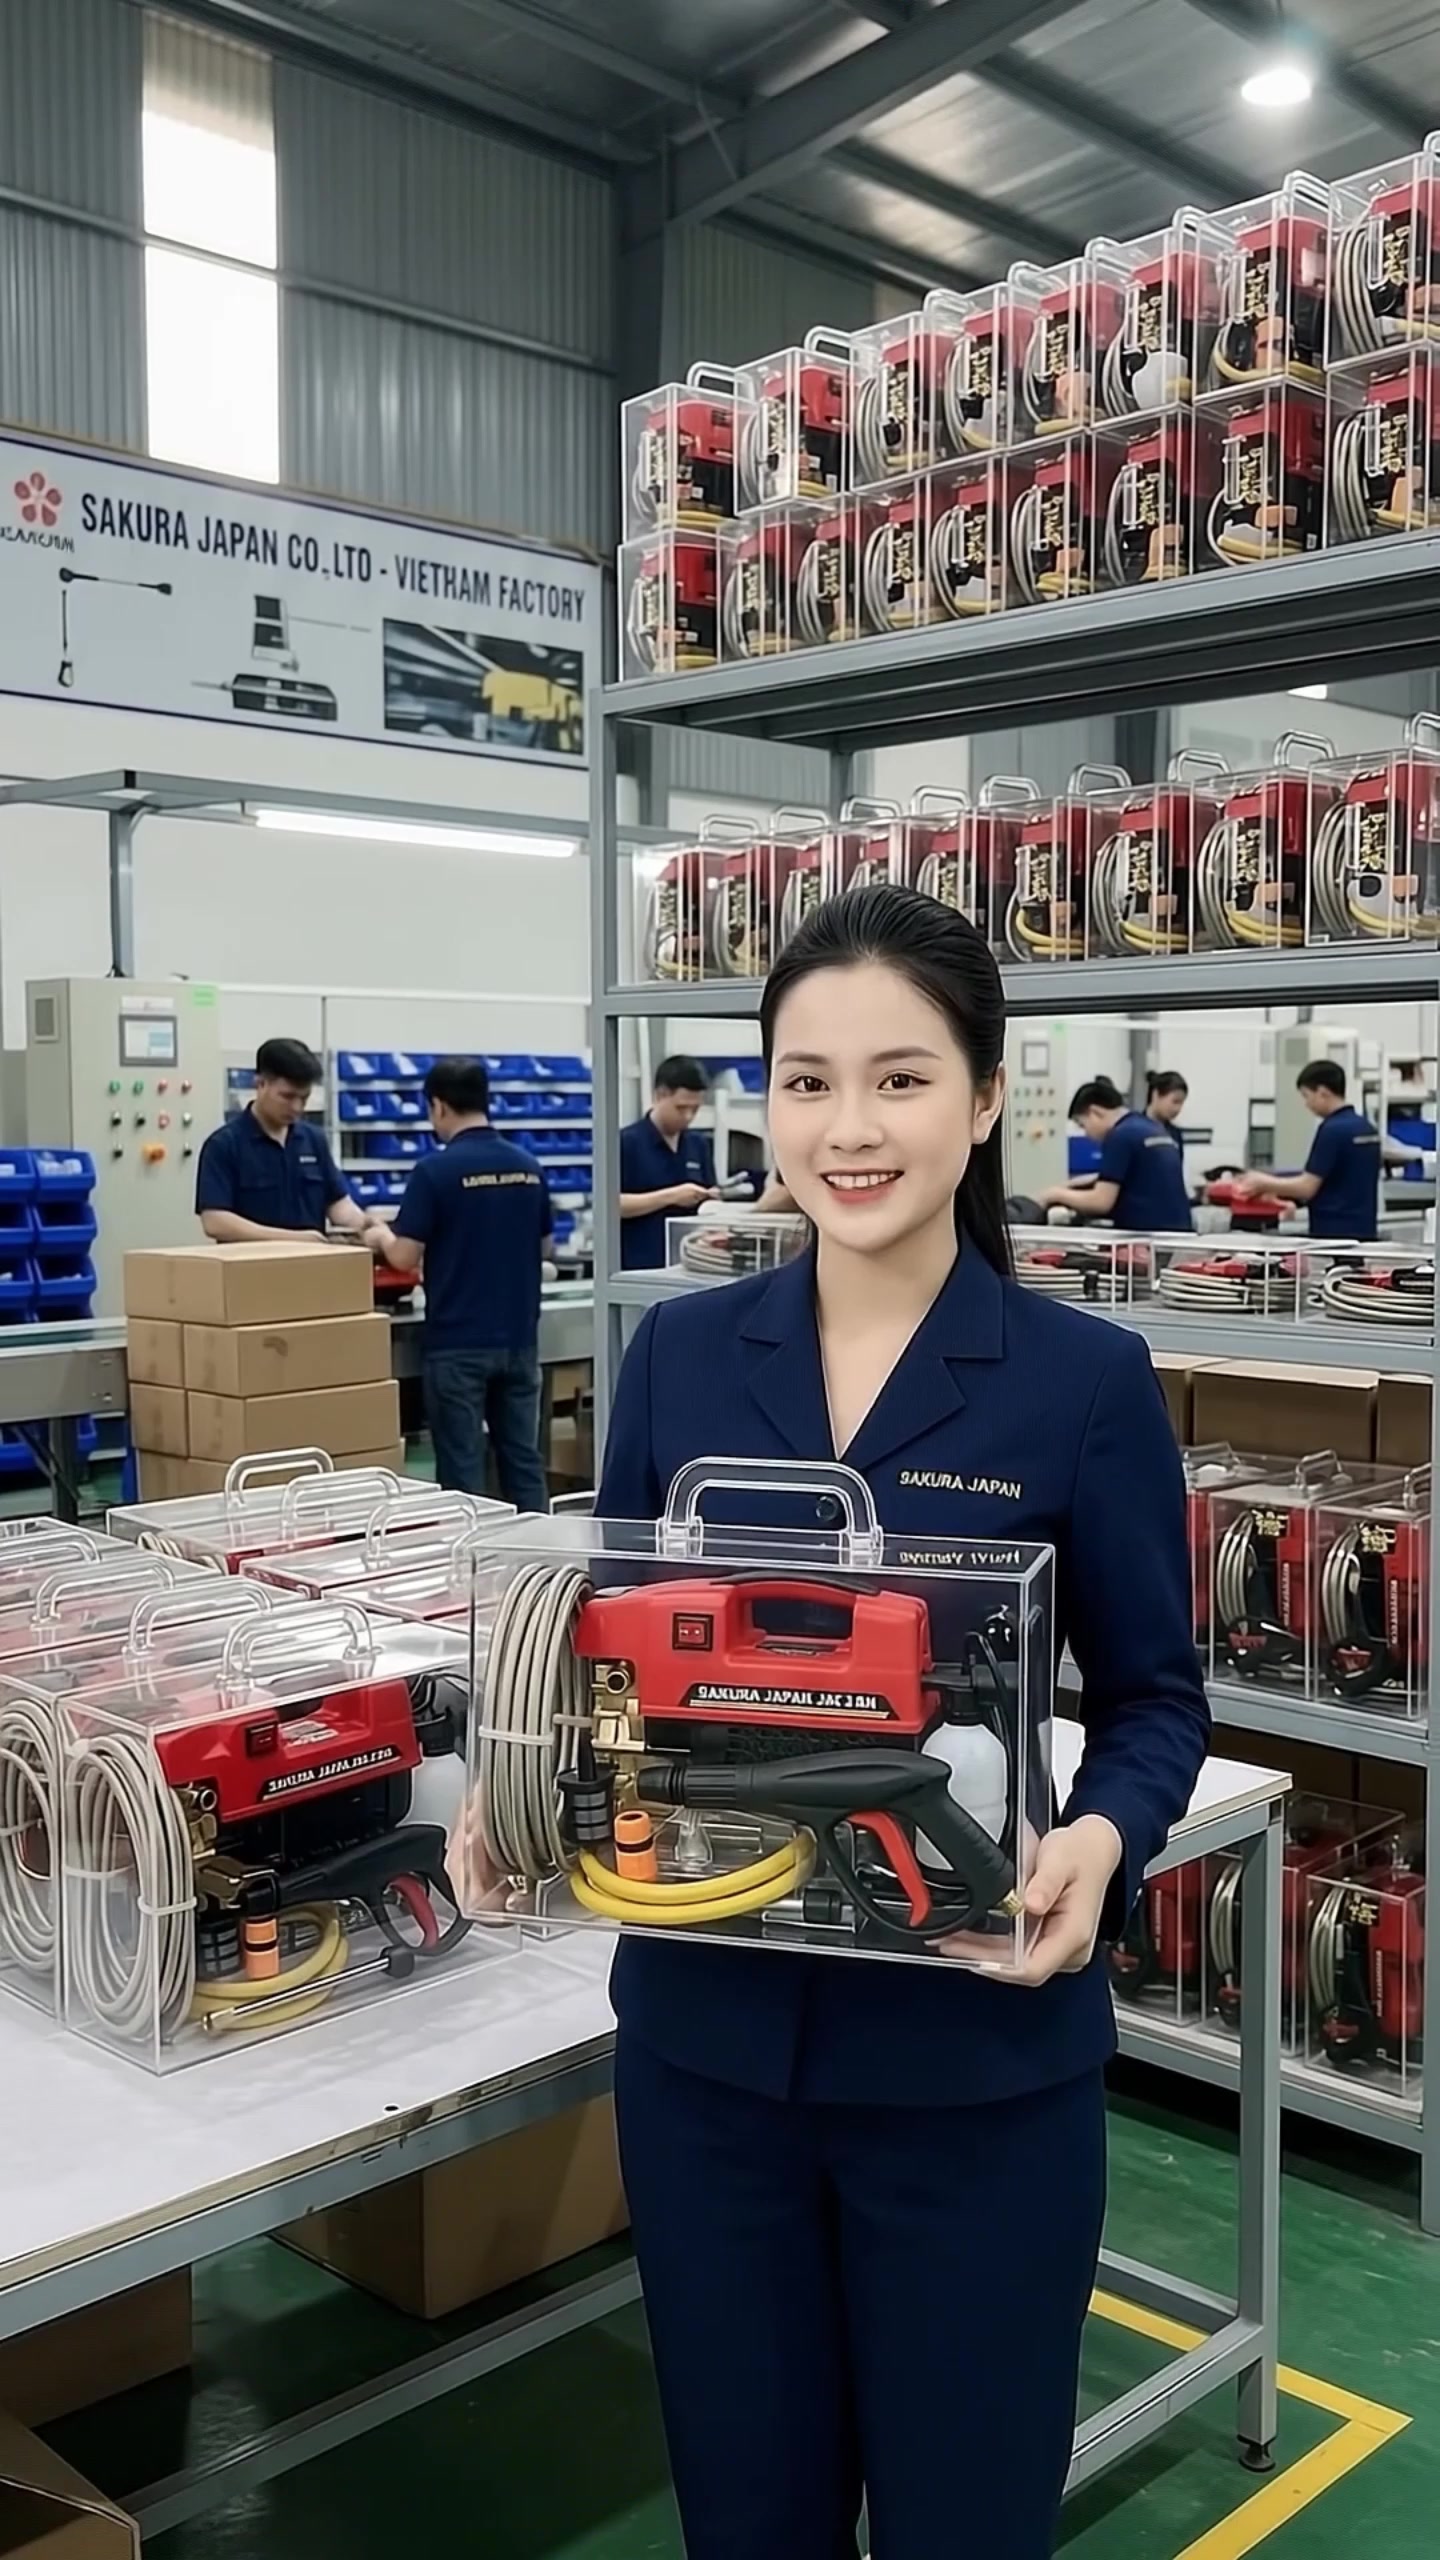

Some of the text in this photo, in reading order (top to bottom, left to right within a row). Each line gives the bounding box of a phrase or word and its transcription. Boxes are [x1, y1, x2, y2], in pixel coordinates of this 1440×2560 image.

[81, 493, 189, 550] SAKURA
[197, 515, 278, 565] JAPAN
[499, 574, 585, 623] FACTORY
[900, 1471, 1021, 1500] SAKURA JAPAN
